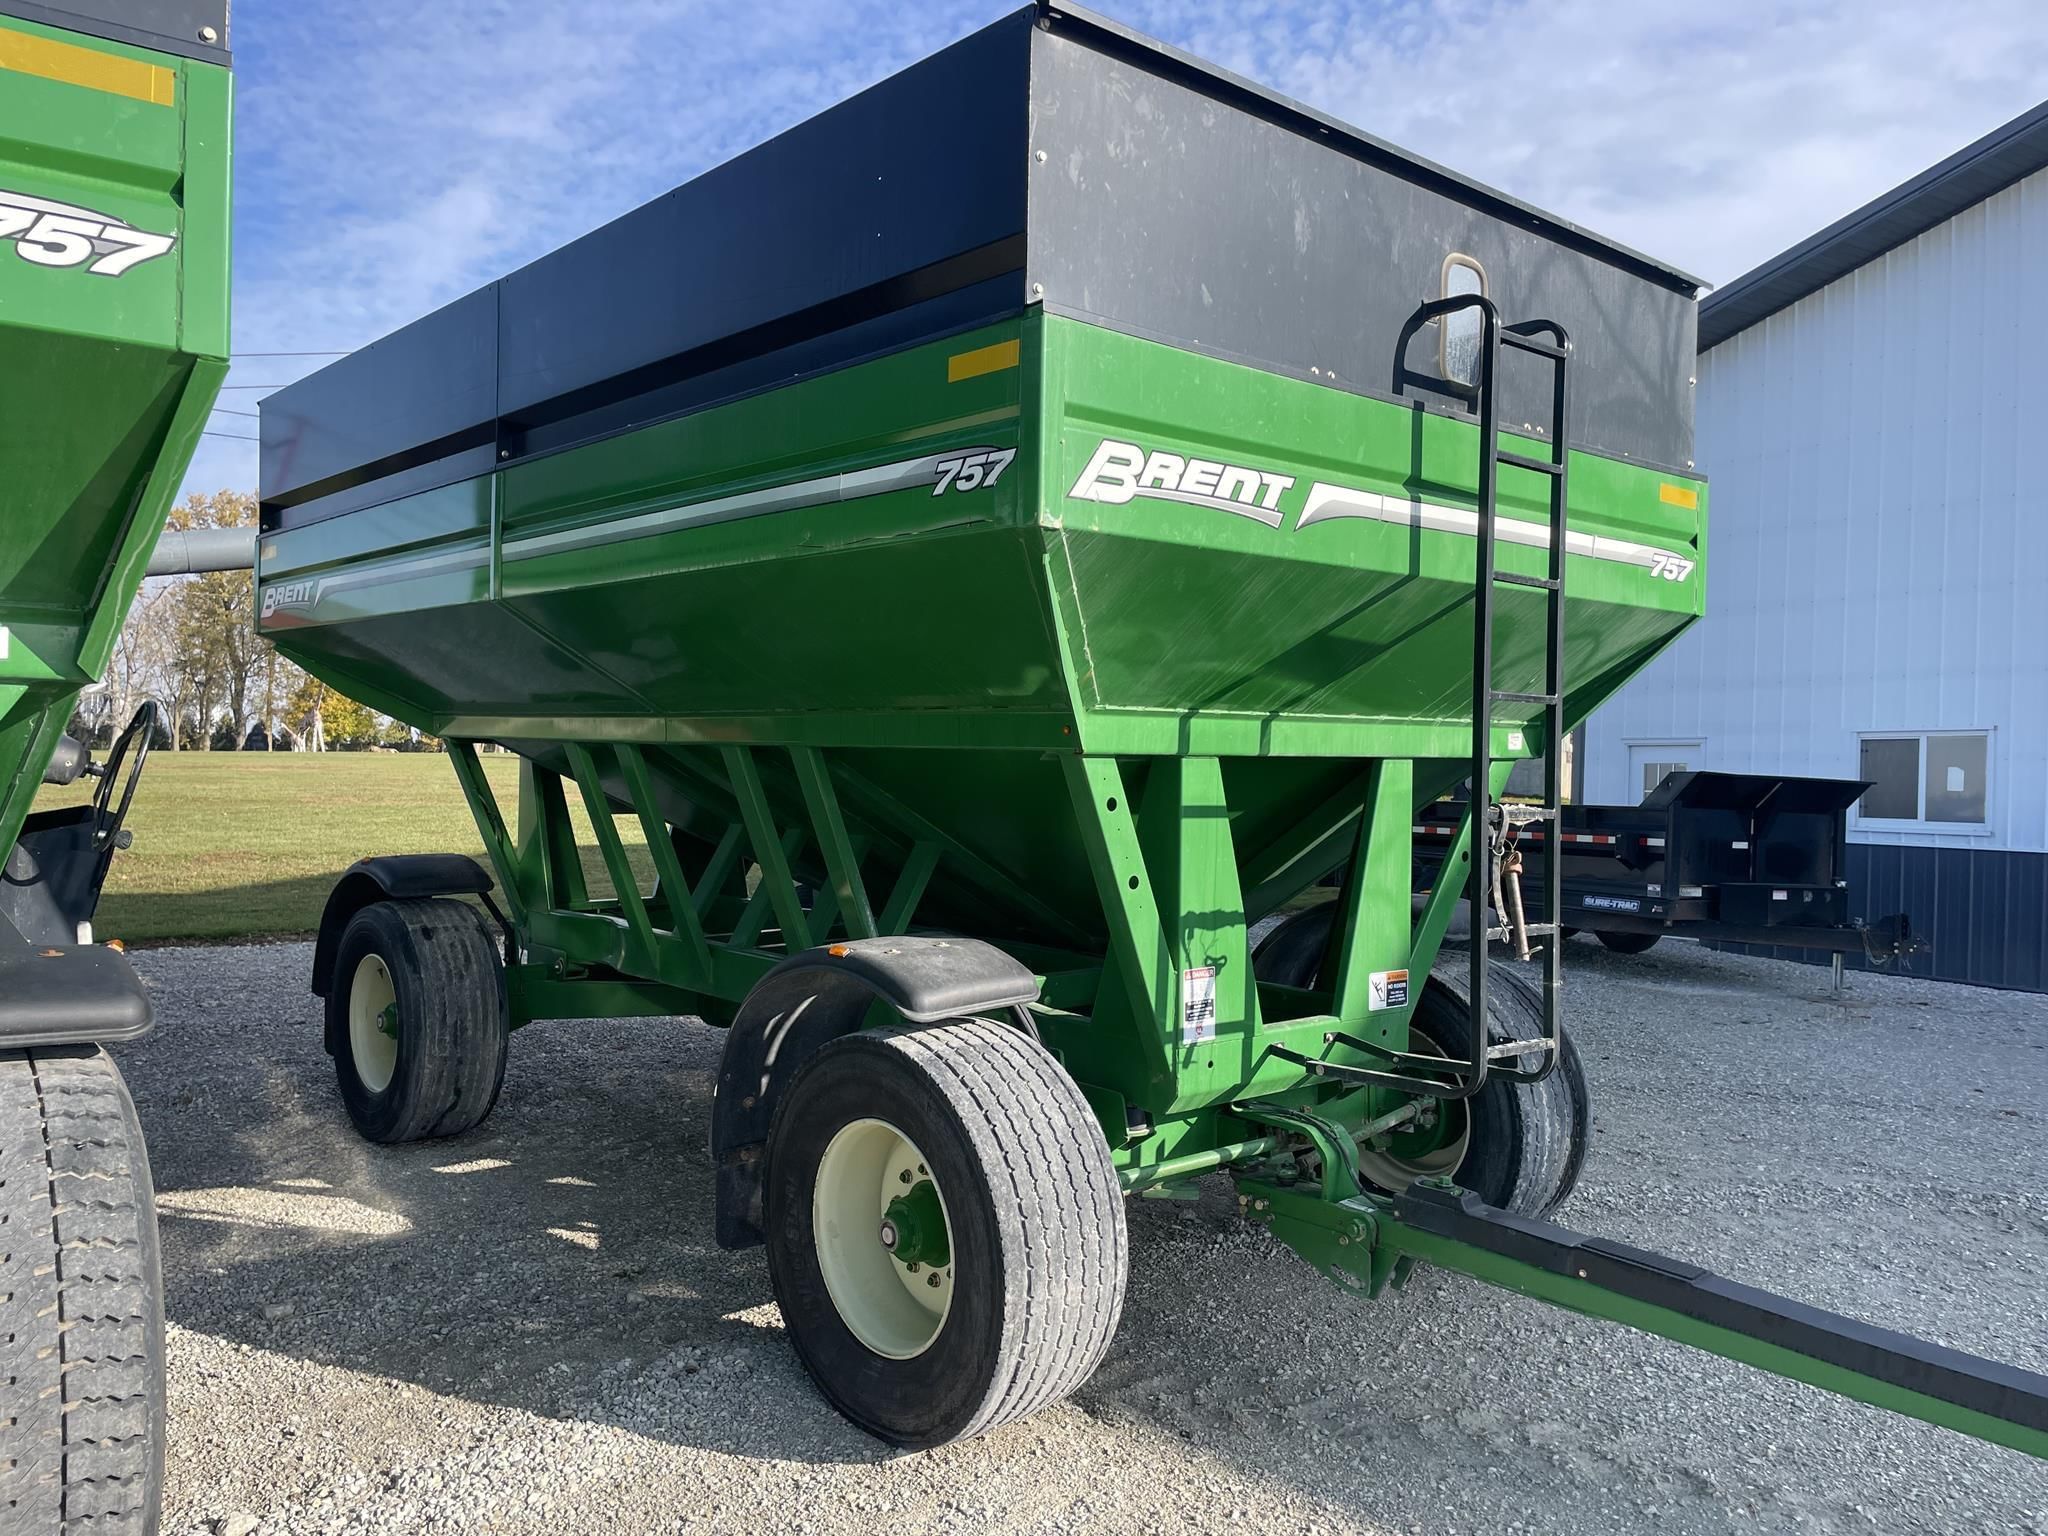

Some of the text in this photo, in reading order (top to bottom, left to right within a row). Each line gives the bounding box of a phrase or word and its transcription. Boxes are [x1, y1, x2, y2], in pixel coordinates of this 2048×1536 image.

[931, 446, 1018, 497] 757
[1067, 438, 1297, 512] BRENT
[1650, 552, 1695, 583] 757
[260, 581, 314, 619] BRENT
[1584, 896, 1639, 910] SURE-TRAC
